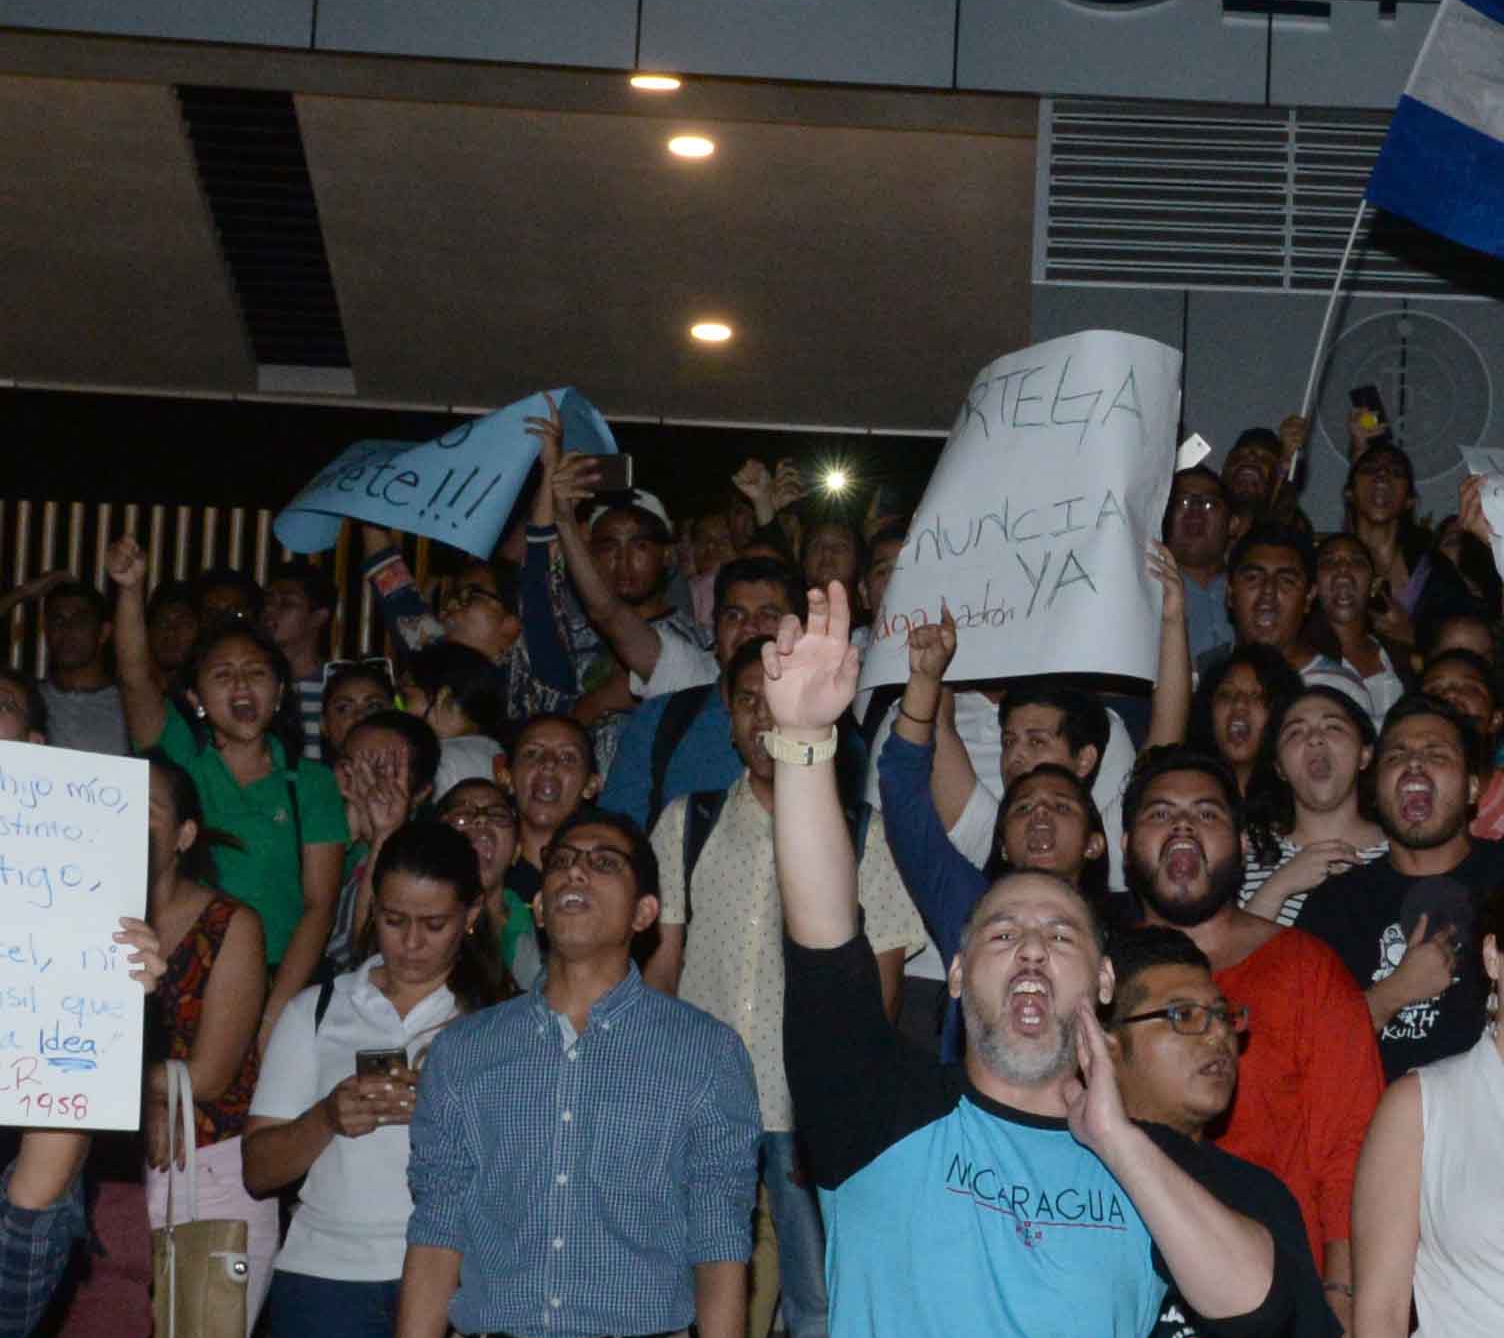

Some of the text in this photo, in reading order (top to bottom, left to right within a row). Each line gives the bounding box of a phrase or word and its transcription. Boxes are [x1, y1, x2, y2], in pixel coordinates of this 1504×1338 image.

[963, 355, 1144, 445] RTEGA
[900, 490, 1128, 569] NUNCIA
[1016, 549, 1098, 617] YA
[19, 1092, 89, 1118] 1958
